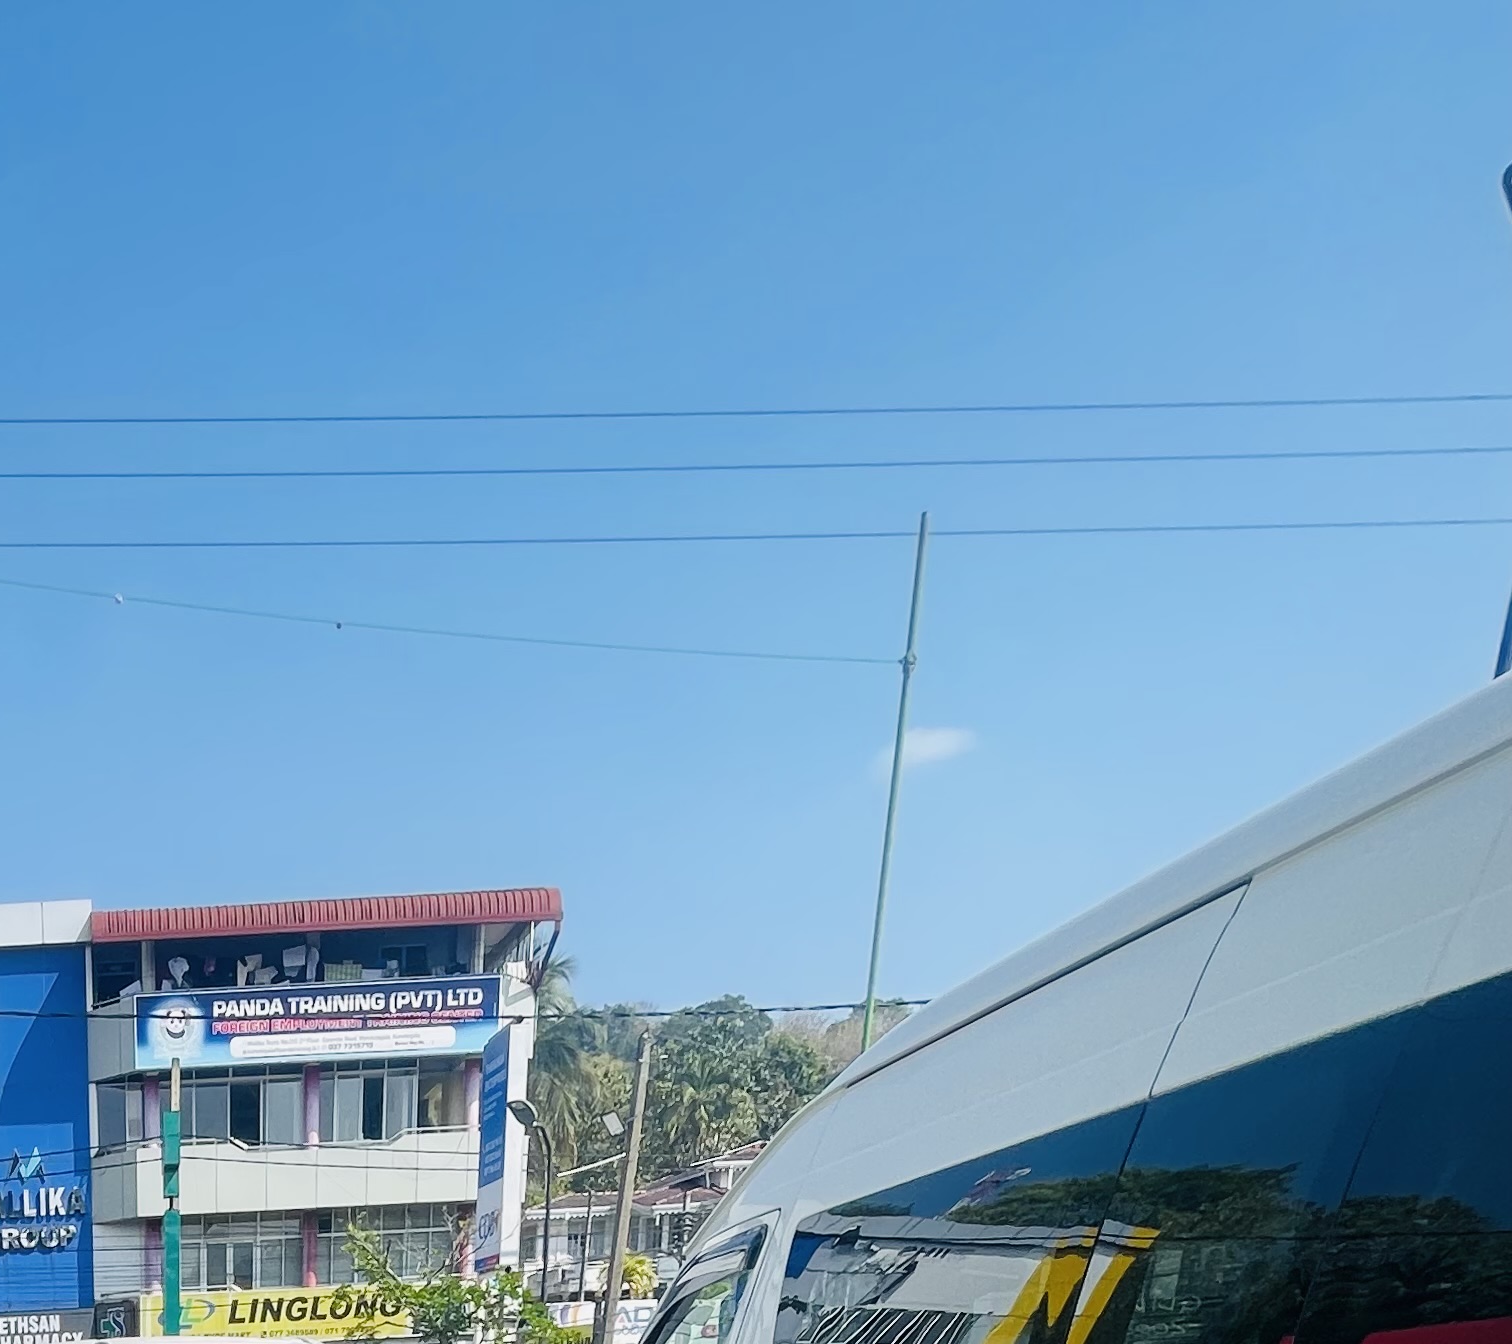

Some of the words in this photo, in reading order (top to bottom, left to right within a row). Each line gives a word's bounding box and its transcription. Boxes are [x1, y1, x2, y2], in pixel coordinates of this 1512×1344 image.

[212, 998, 284, 1018] PANDA
[288, 992, 386, 1015] TRAINING
[390, 989, 443, 1013] (PVT)
[447, 988, 483, 1007] LTD
[211, 1019, 270, 1035] FOREIGN
[271, 1015, 363, 1033] EMPLOYMENT
[228, 1293, 401, 1325] LINGLONG
